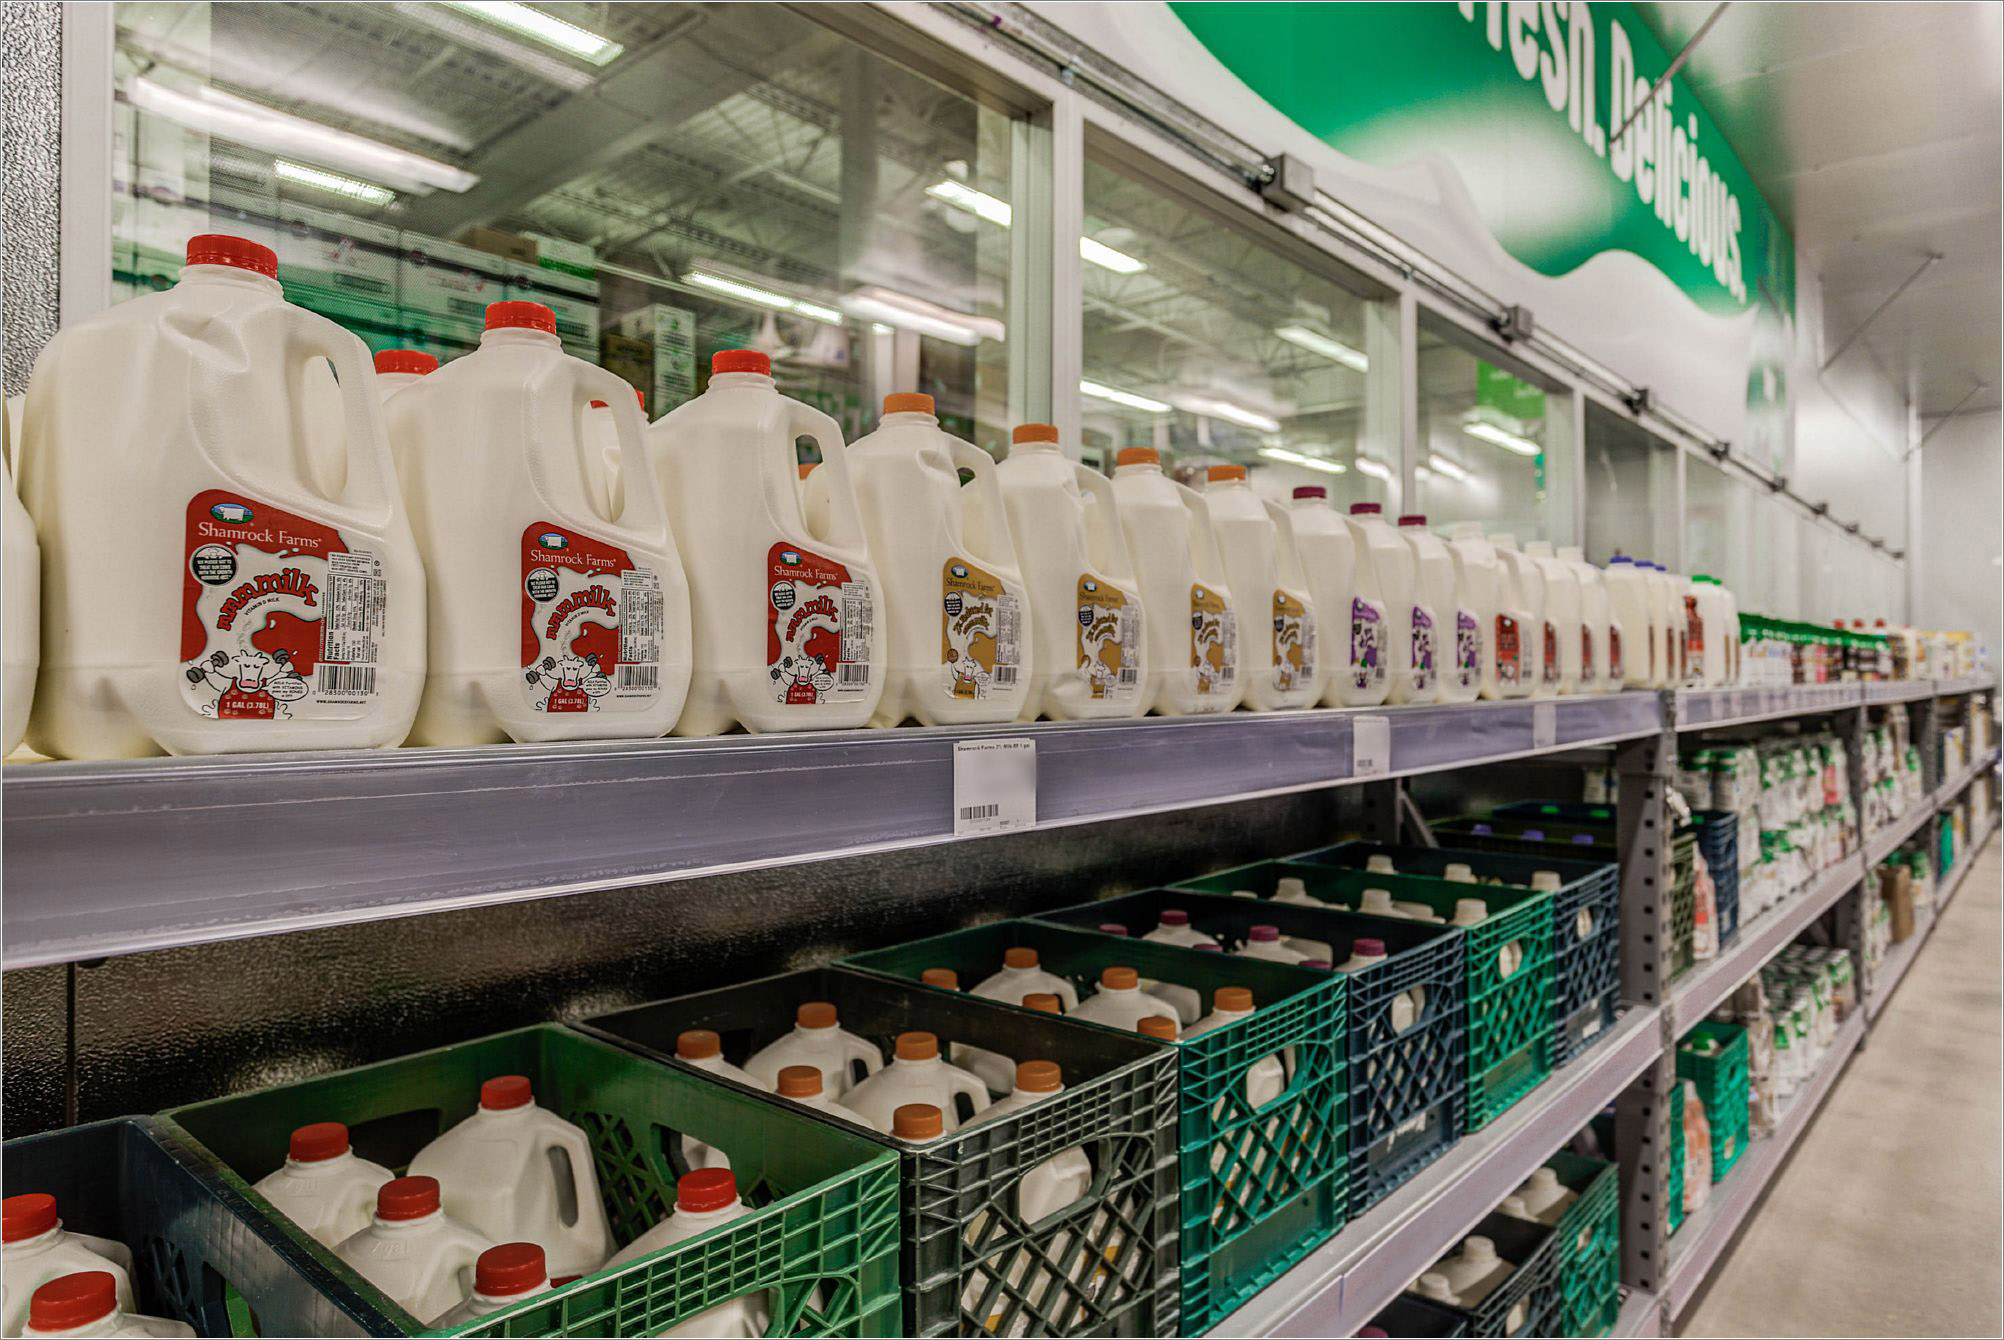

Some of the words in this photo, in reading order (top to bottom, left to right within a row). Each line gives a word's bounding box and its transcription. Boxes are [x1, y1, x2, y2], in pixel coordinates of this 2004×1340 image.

[1610, 18, 1747, 304] Delicious.
[198, 521, 274, 543] Shamrock
[530, 549, 583, 564] Shamrock
[774, 565, 813, 578] Shamrock
